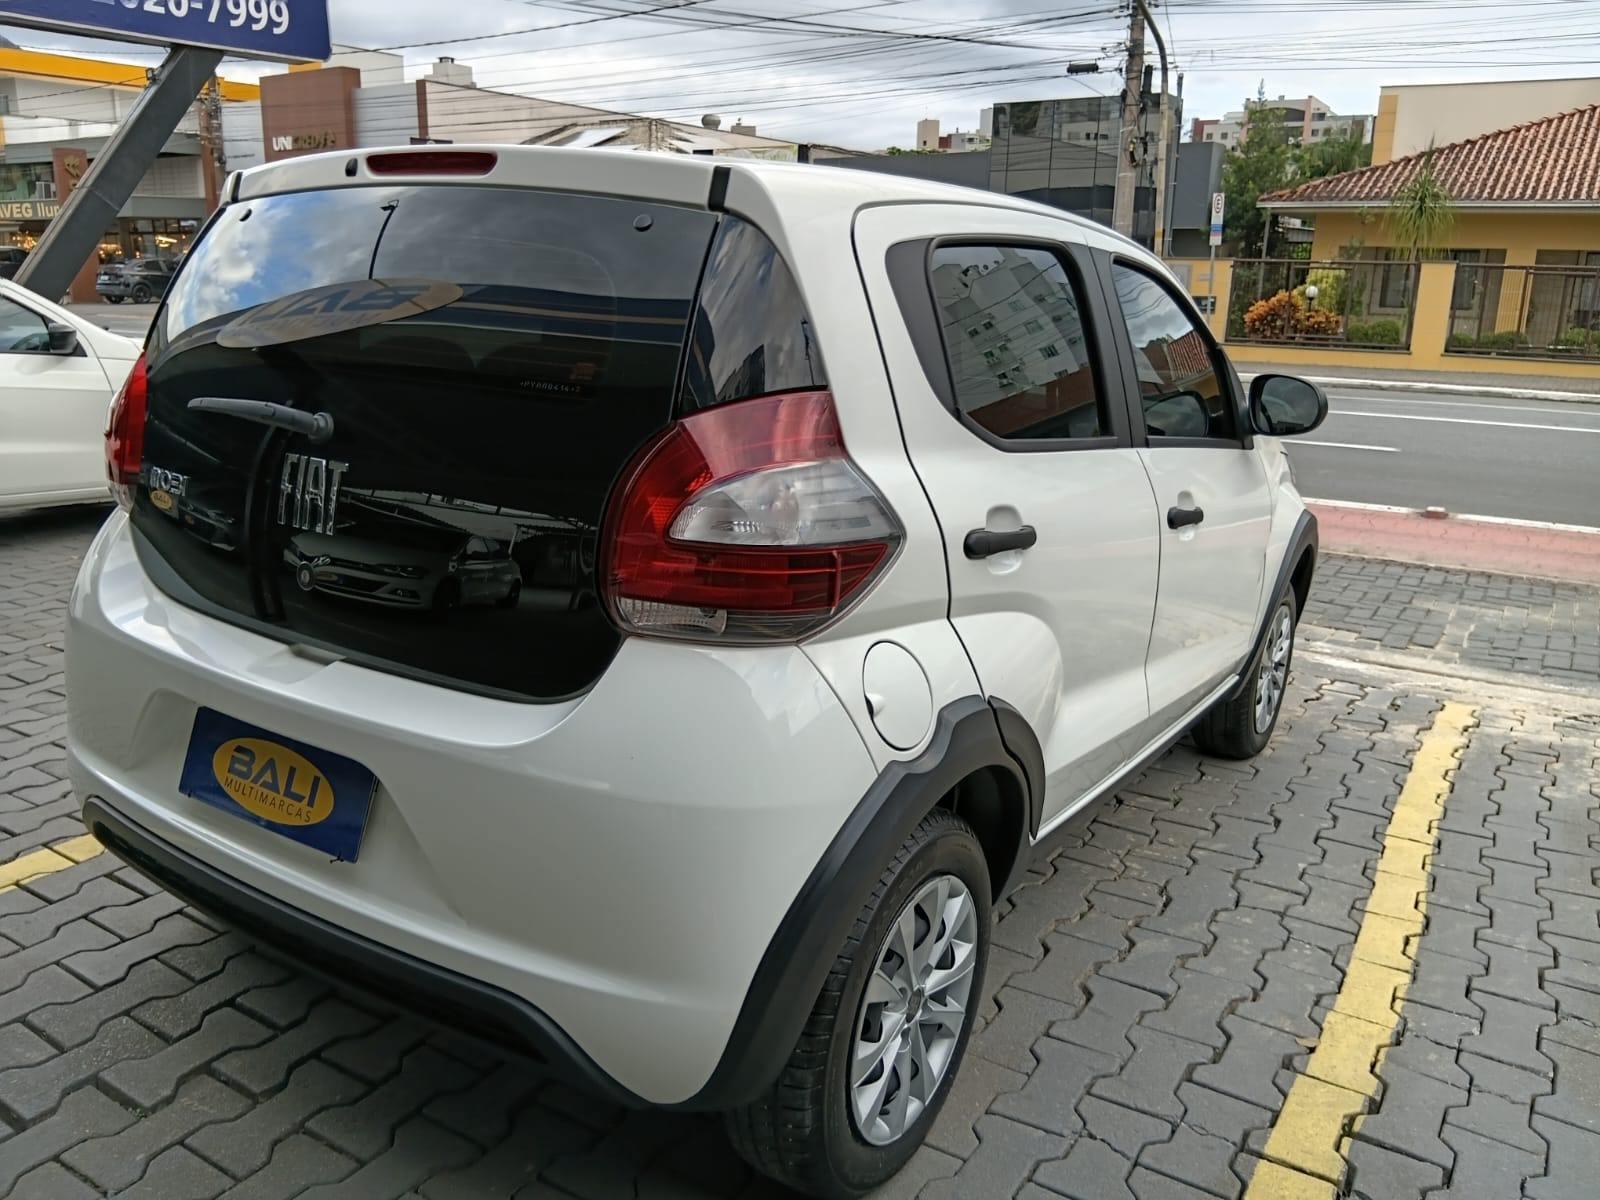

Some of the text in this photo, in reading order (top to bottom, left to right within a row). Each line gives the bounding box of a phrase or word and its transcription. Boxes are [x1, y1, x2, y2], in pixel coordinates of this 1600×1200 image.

[278, 453, 349, 535] FIAT
[224, 776, 312, 823] MULTIMARCAS
[228, 745, 321, 808] BALI
